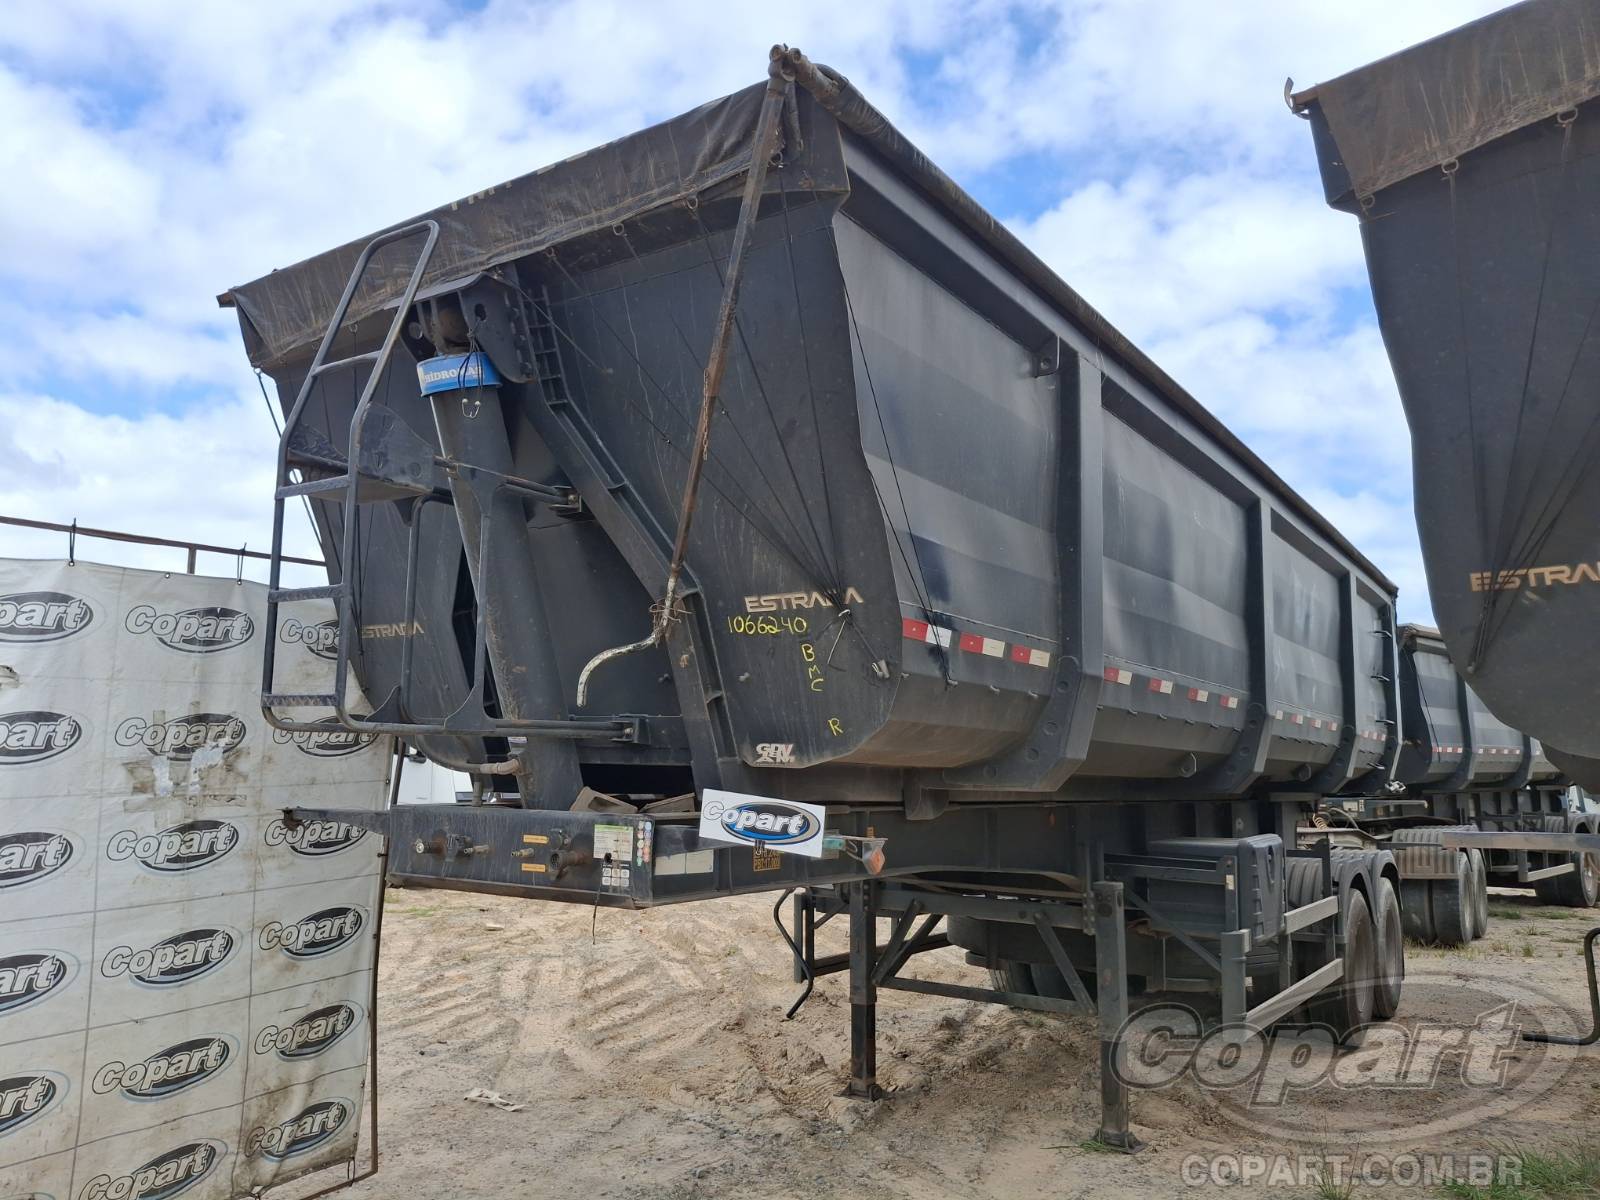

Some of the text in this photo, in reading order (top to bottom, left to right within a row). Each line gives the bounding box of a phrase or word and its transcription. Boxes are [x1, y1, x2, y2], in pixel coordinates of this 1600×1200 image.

[1470, 561, 1600, 592] ESTRA
[0, 598, 86, 630] part
[125, 605, 249, 643] Copart
[361, 619, 425, 639] STRAA
[728, 615, 807, 635] 1066240
[280, 618, 340, 651] Cop
[0, 715, 75, 749] art
[115, 716, 241, 753] Copart
[703, 800, 804, 836] Copart
[0, 834, 67, 872] art
[106, 822, 235, 864] Copart
[259, 908, 359, 951] Copart
[101, 929, 228, 978] Copart
[254, 1005, 352, 1055] Copart
[92, 1037, 226, 1095] Copart
[244, 1101, 343, 1158] Copart
[78, 1142, 210, 1200] Copart
